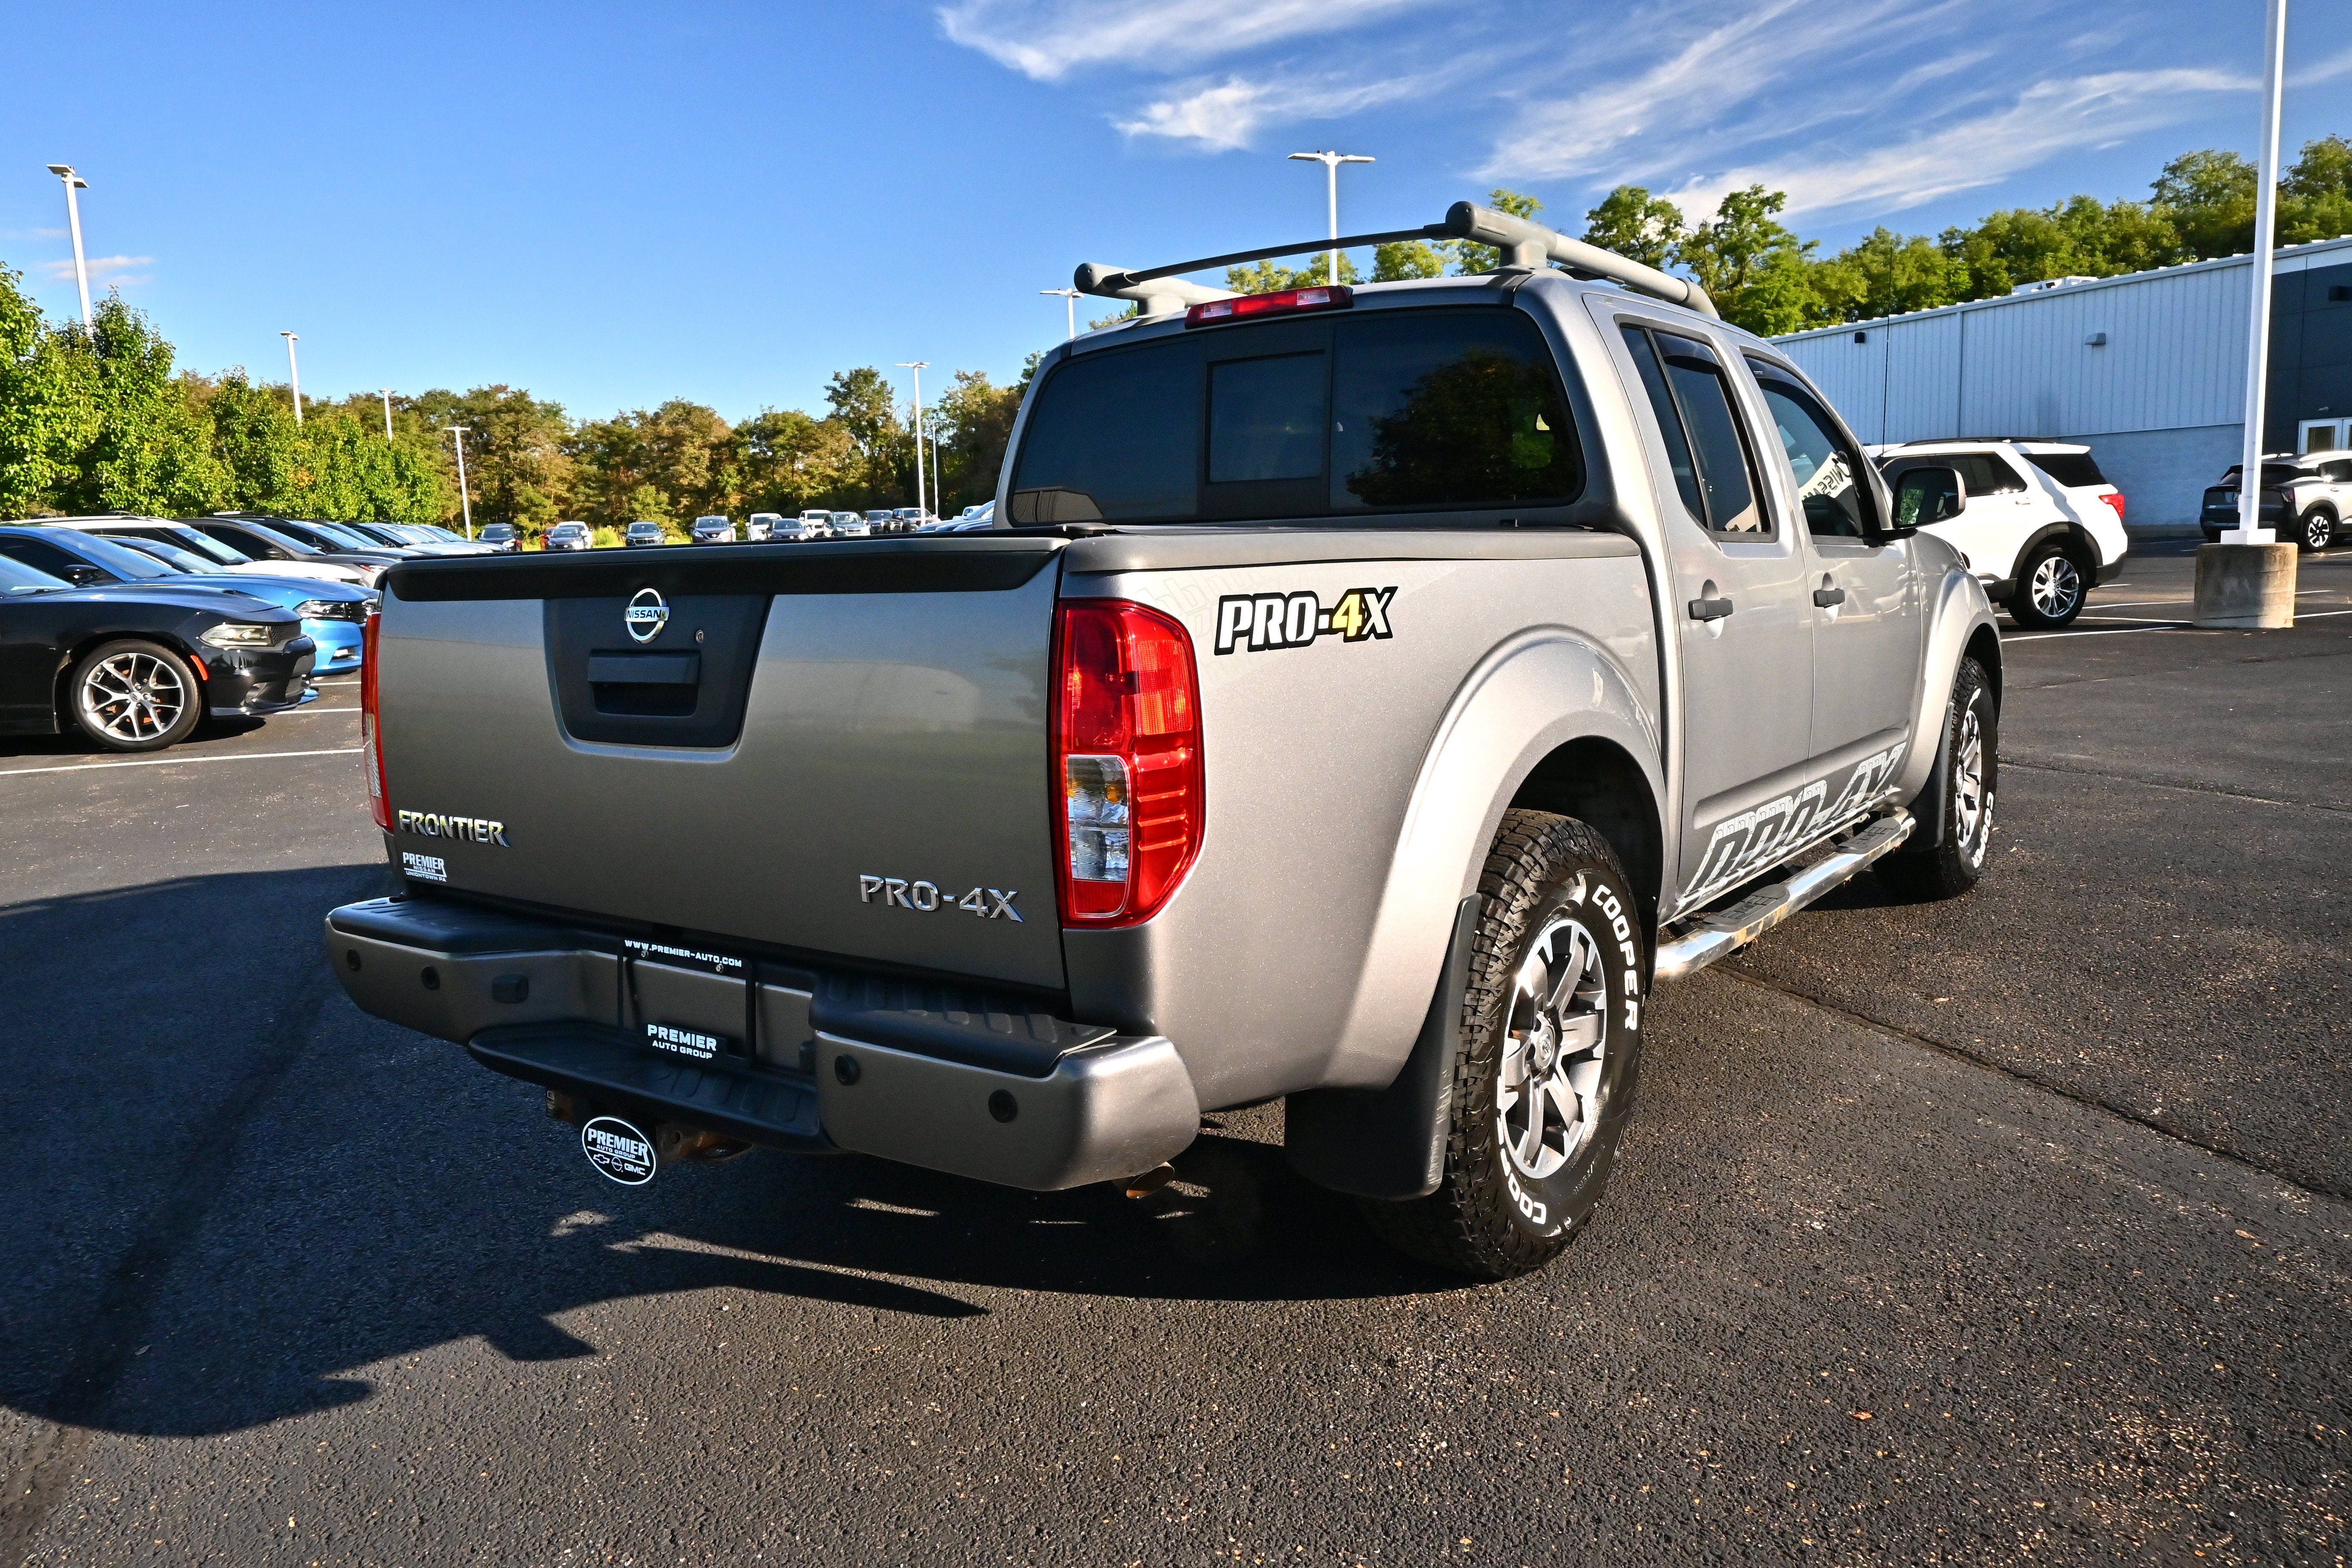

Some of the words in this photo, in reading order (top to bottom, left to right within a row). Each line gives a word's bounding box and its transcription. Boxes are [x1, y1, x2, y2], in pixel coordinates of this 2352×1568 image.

[627, 610, 662, 618] NISSAN
[1215, 587, 1398, 655] PRO-4X
[399, 809, 510, 847] FRONTIER
[403, 852, 445, 871] PREMIER
[413, 865, 436, 874] NISSAN
[406, 870, 438, 881] UNIONTOWN
[860, 874, 1025, 923] PRO-4X
[624, 939, 742, 967] WWW.PREMIER-AUTO.COM
[1592, 884, 1638, 1031] COOPER
[648, 1024, 717, 1051] PREMIER
[652, 1040, 678, 1052] AUTO
[679, 1046, 713, 1059] GROUP
[588, 1127, 648, 1160] PREMIER
[596, 1144, 613, 1153] AUTO
[614, 1149, 636, 1159] GROUP
[624, 1162, 646, 1176] GMC
